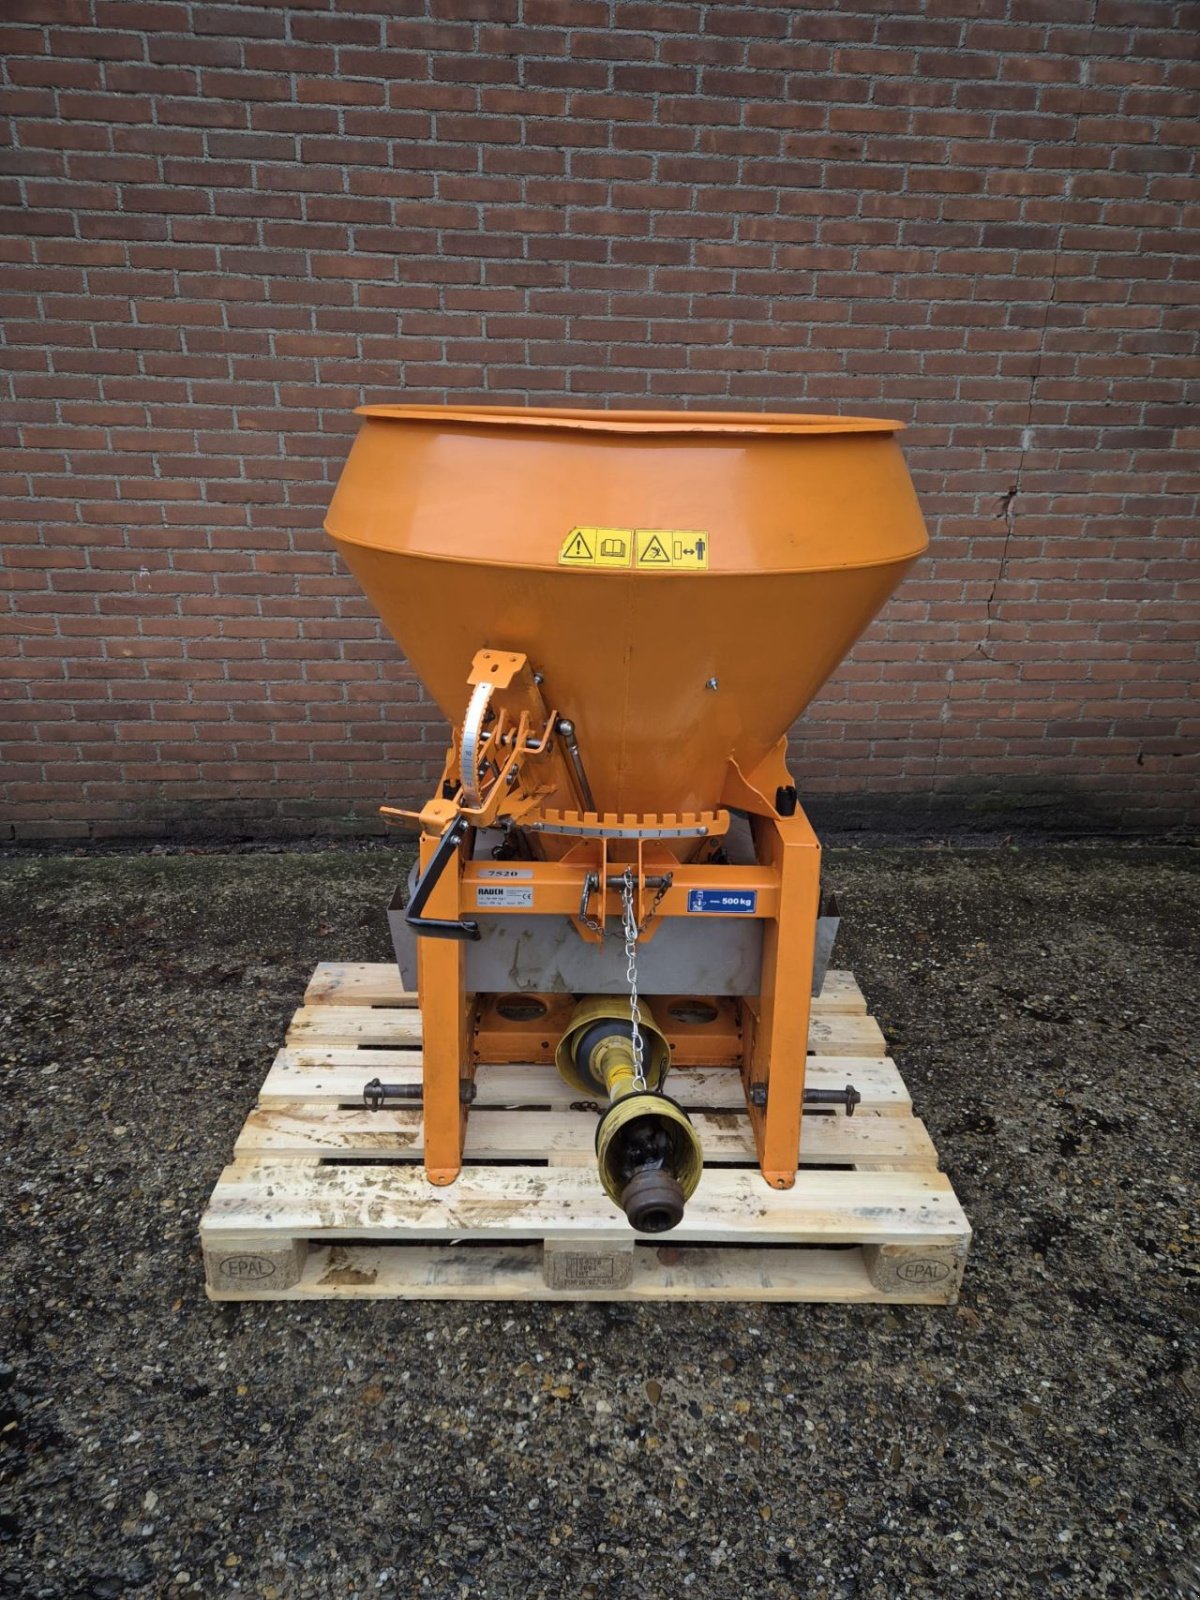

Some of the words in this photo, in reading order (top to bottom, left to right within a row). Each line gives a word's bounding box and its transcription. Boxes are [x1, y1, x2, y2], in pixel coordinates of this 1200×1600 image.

[740, 898, 752, 906] kg
[228, 1260, 267, 1275] EPAL
[905, 1264, 938, 1278] EPAL
